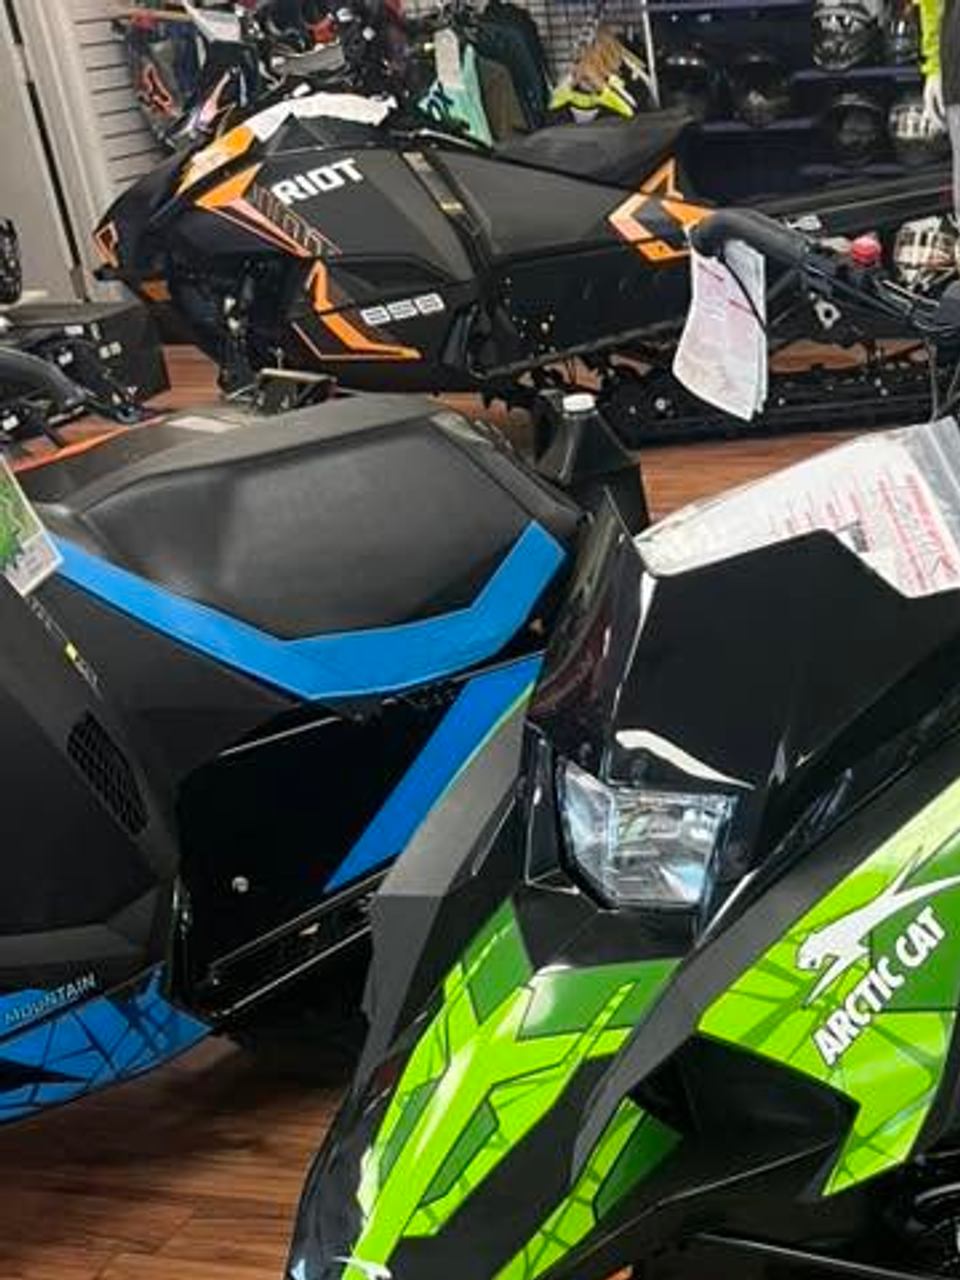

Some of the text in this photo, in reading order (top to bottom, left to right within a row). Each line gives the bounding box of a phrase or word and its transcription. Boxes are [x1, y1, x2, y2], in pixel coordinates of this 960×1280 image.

[270, 157, 365, 206] RIOT
[4, 971, 97, 1026] MOUNTAIN
[813, 905, 946, 1066] ARCTIC CAT
